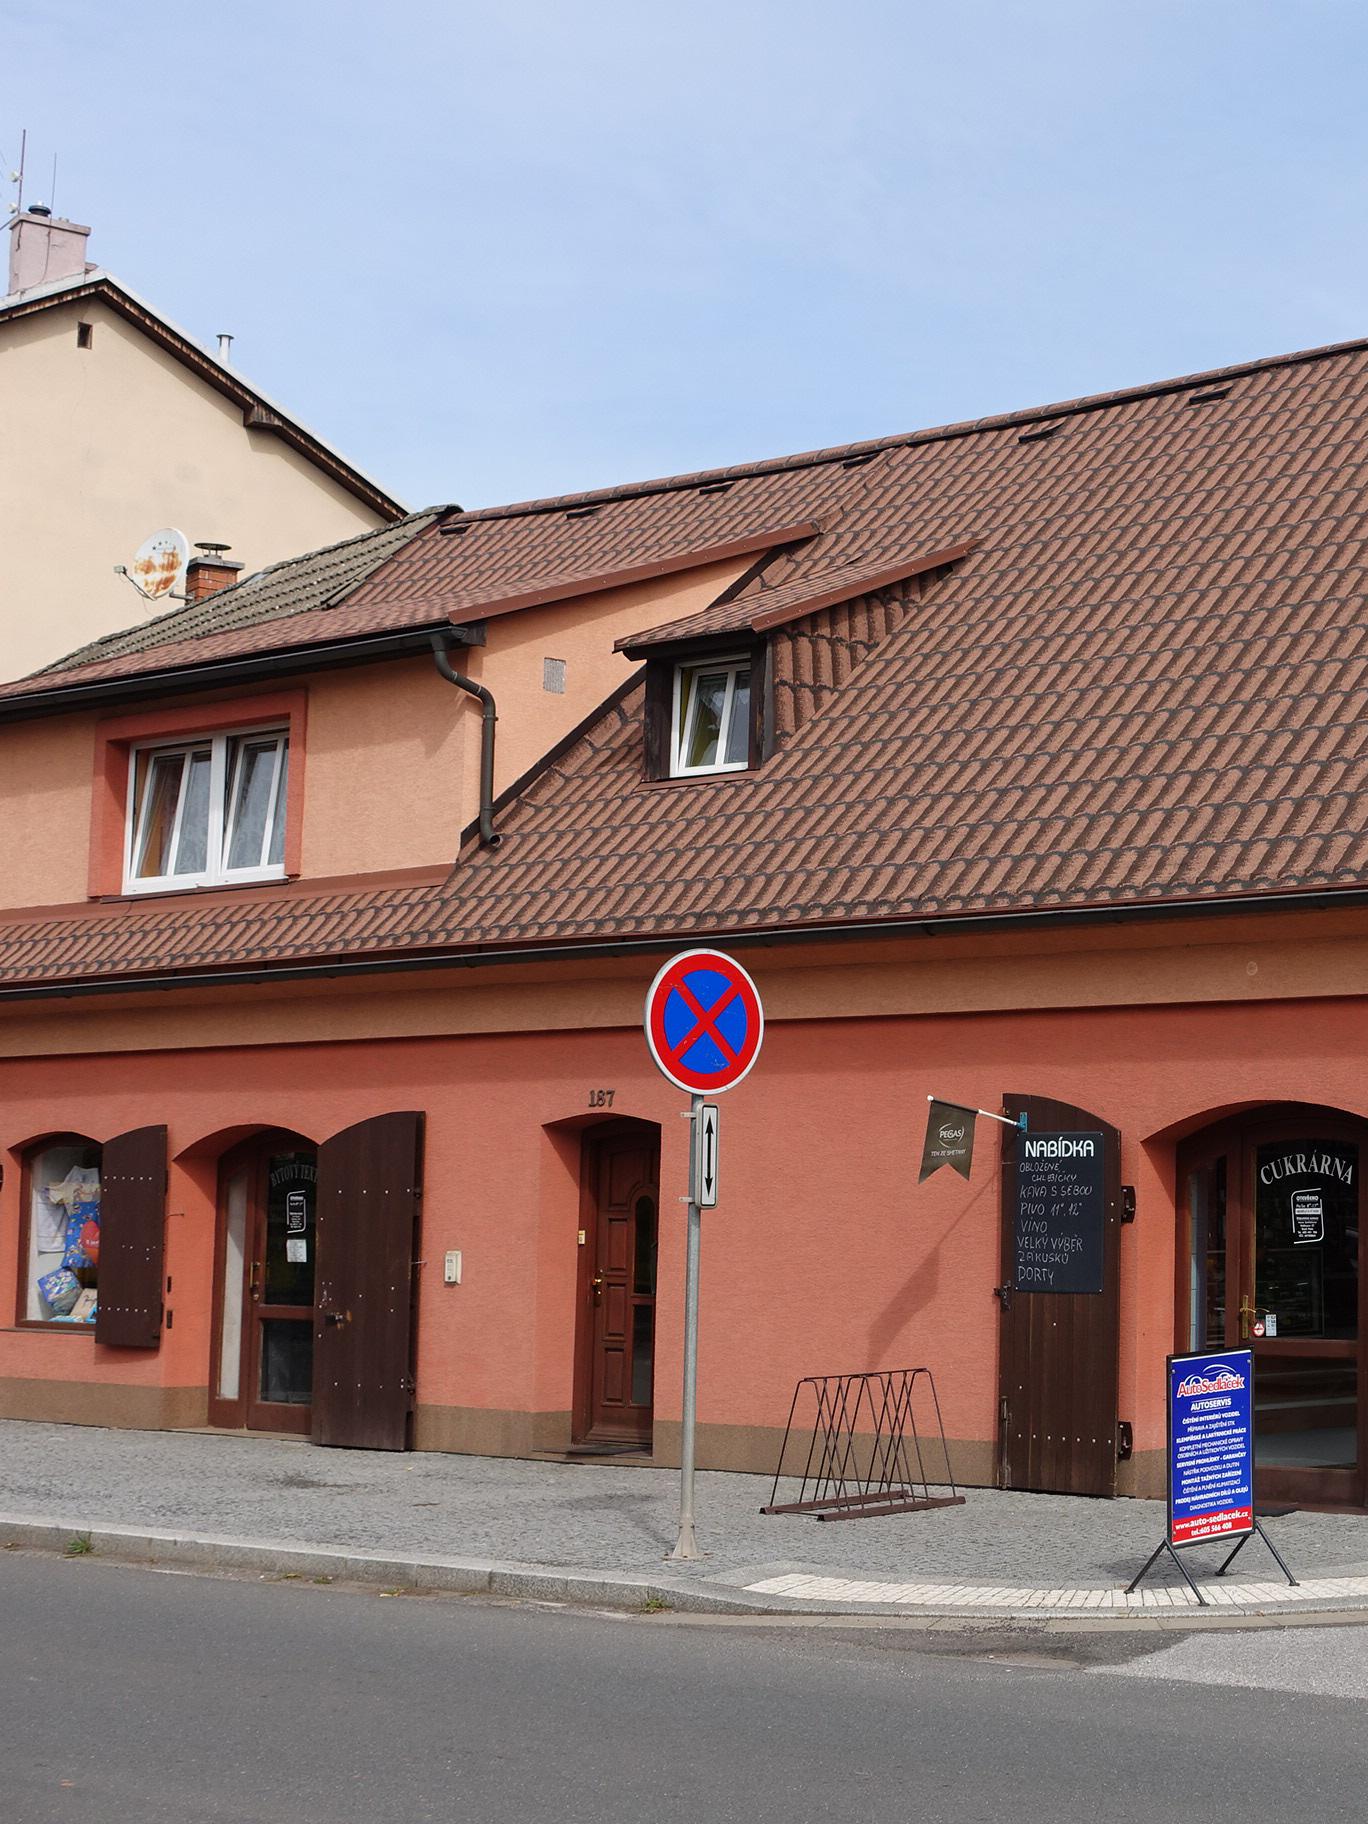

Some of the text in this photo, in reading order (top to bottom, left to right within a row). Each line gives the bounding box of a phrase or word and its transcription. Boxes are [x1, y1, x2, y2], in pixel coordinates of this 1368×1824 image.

[589, 1089, 615, 1107] 187
[940, 1129, 961, 1138] PEGAS
[1025, 1137, 1094, 1157] NABÍDKA
[1260, 1149, 1352, 1184] CUKRÁRNA
[1051, 1185, 1057, 1197] S
[1060, 1185, 1092, 1197] SEBOU
[1020, 1202, 1045, 1216] PIVO
[1018, 1265, 1054, 1285] DORTY
[1191, 1398, 1232, 1411] AUTOSERVIS
[1175, 1510, 1248, 1530] www.auto-sedlacek.cz
